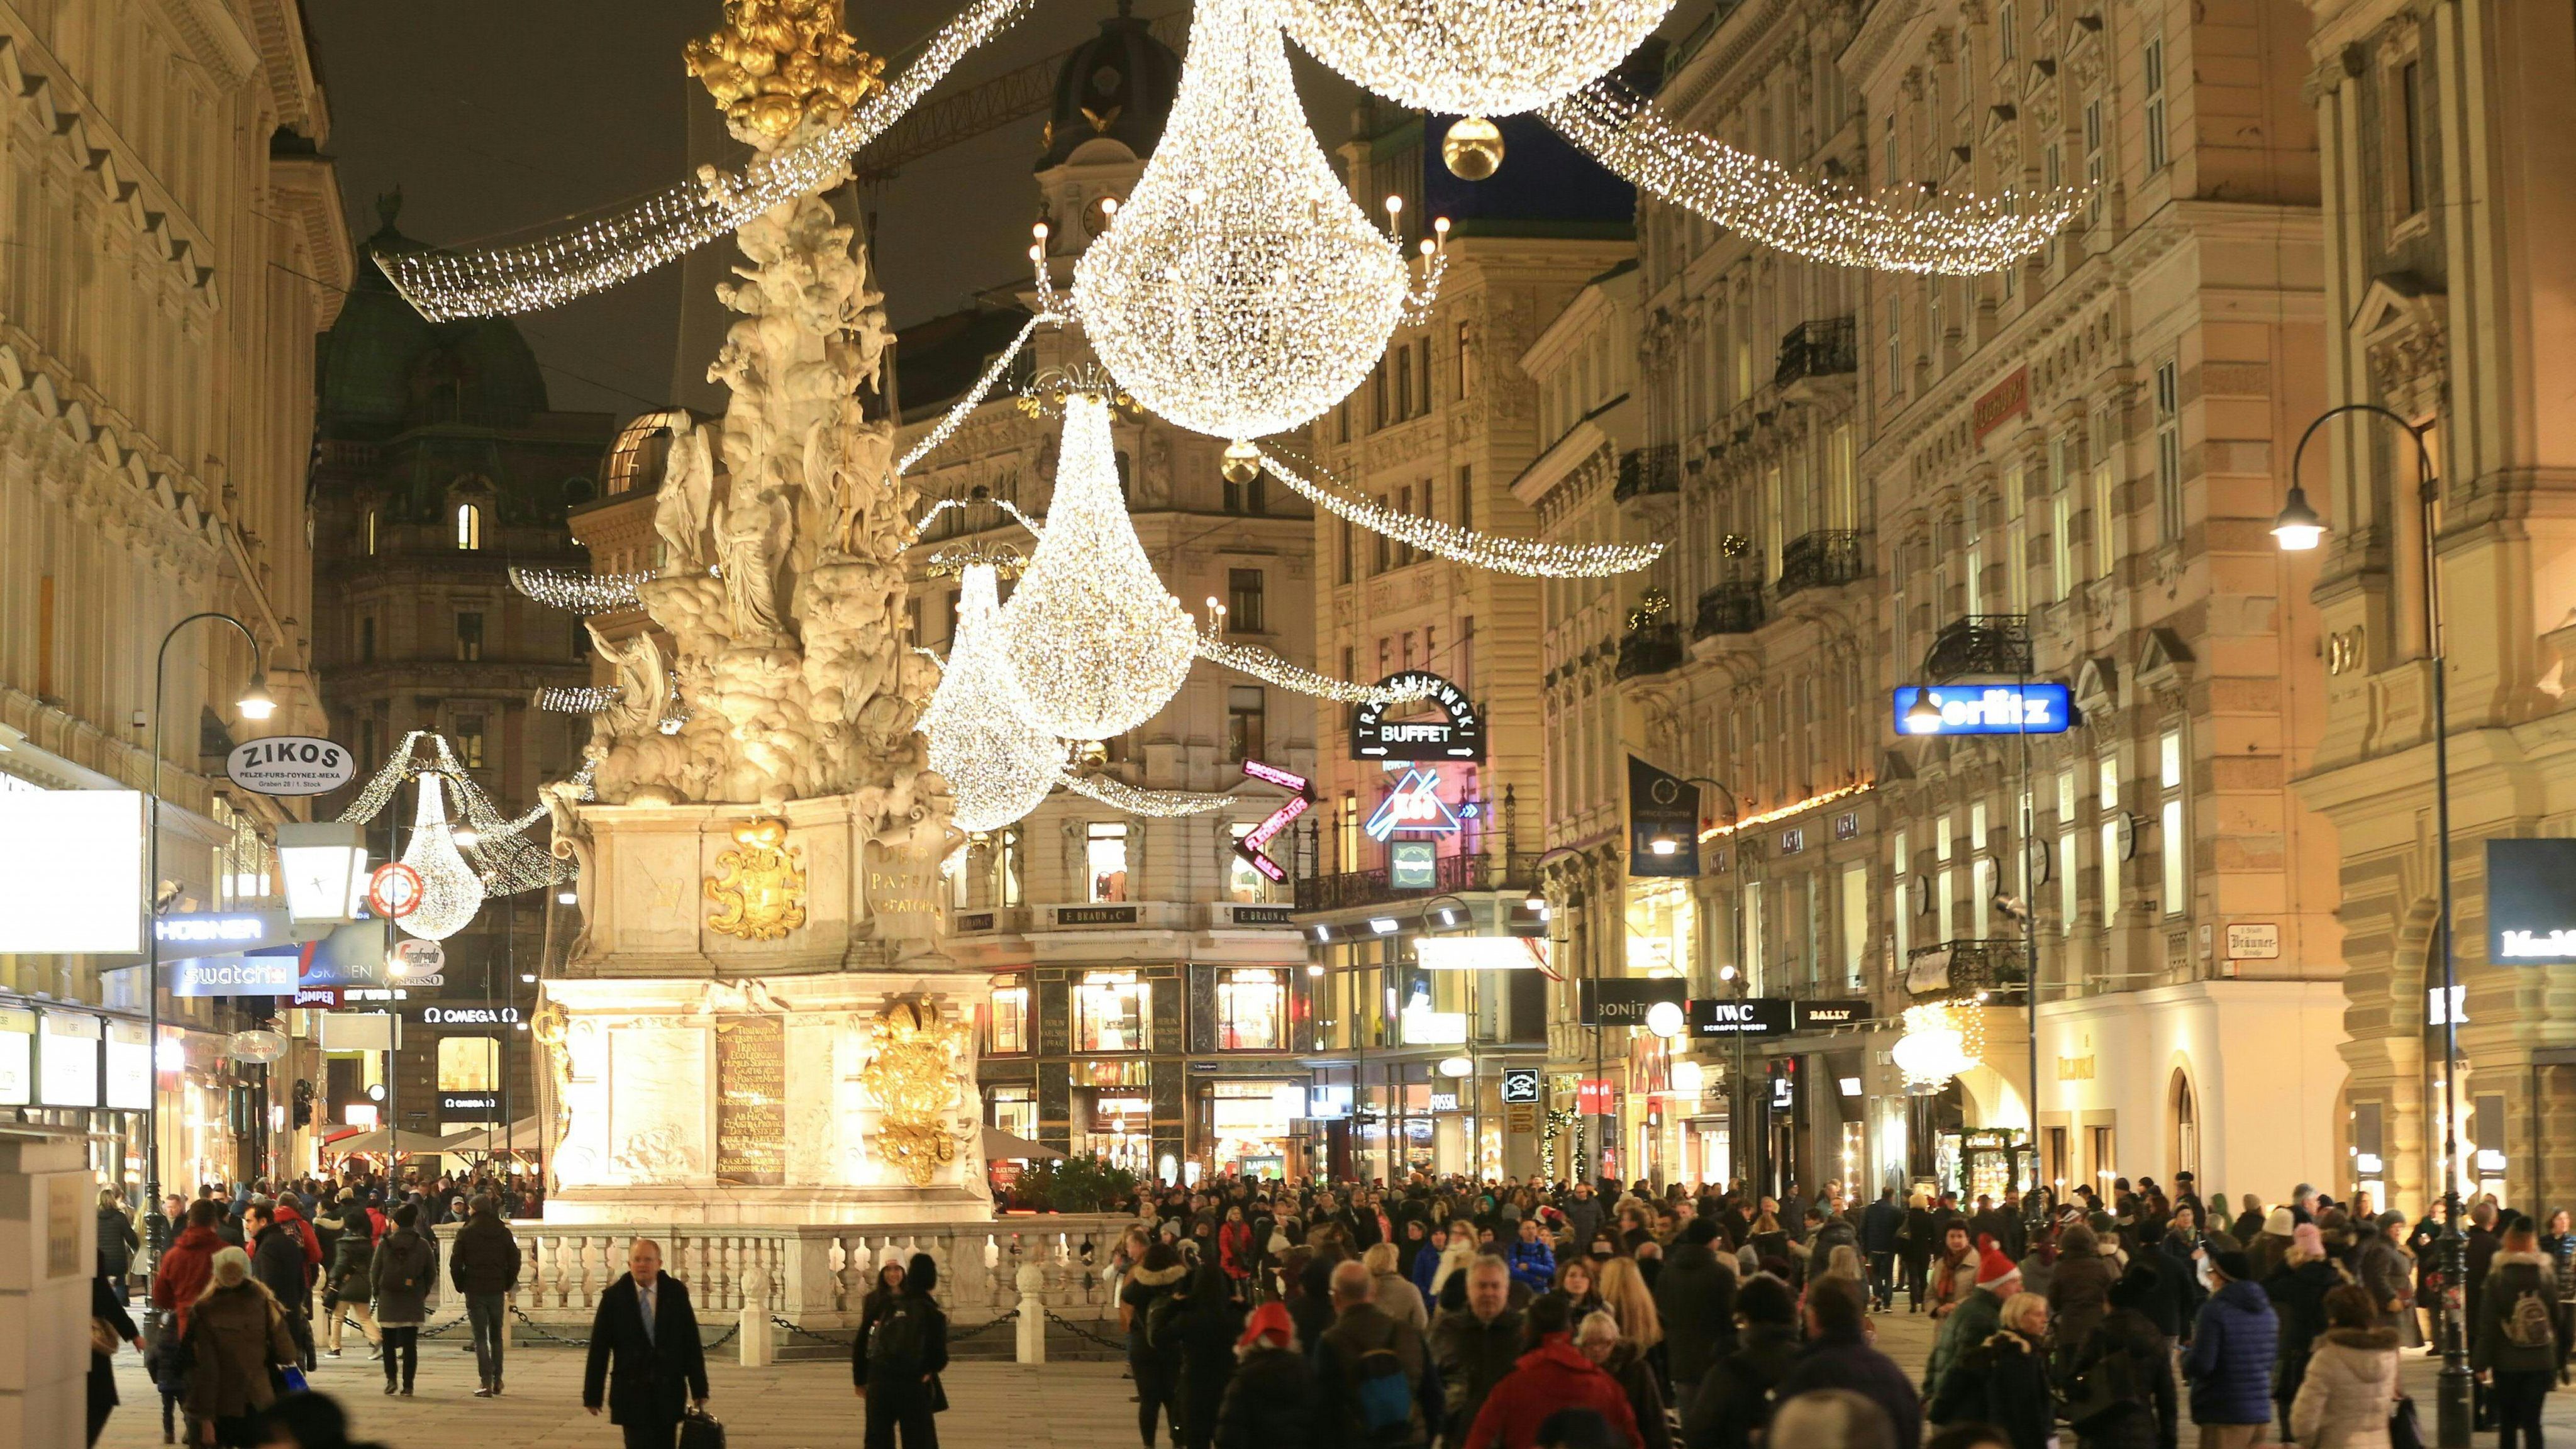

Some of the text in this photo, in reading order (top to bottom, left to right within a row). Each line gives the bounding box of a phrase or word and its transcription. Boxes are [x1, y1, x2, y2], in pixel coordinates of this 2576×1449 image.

[1928, 689, 2050, 725] erlitz
[1381, 725, 1452, 742] BUFFET
[243, 743, 340, 769] ZIKOS
[1077, 911, 1107, 921] BRAUN
[1250, 911, 1279, 921] BRAUN
[184, 964, 271, 985] swatch
[397, 975, 440, 985] SPRESSO
[294, 991, 335, 1006] CAMPER
[444, 1008, 498, 1023] OMEGA
[1716, 1004, 1754, 1022] IWC
[1809, 1010, 1850, 1020] BALLY
[456, 1100, 485, 1108] OMEGA
[1431, 1094, 1458, 1110] FOSSIL
